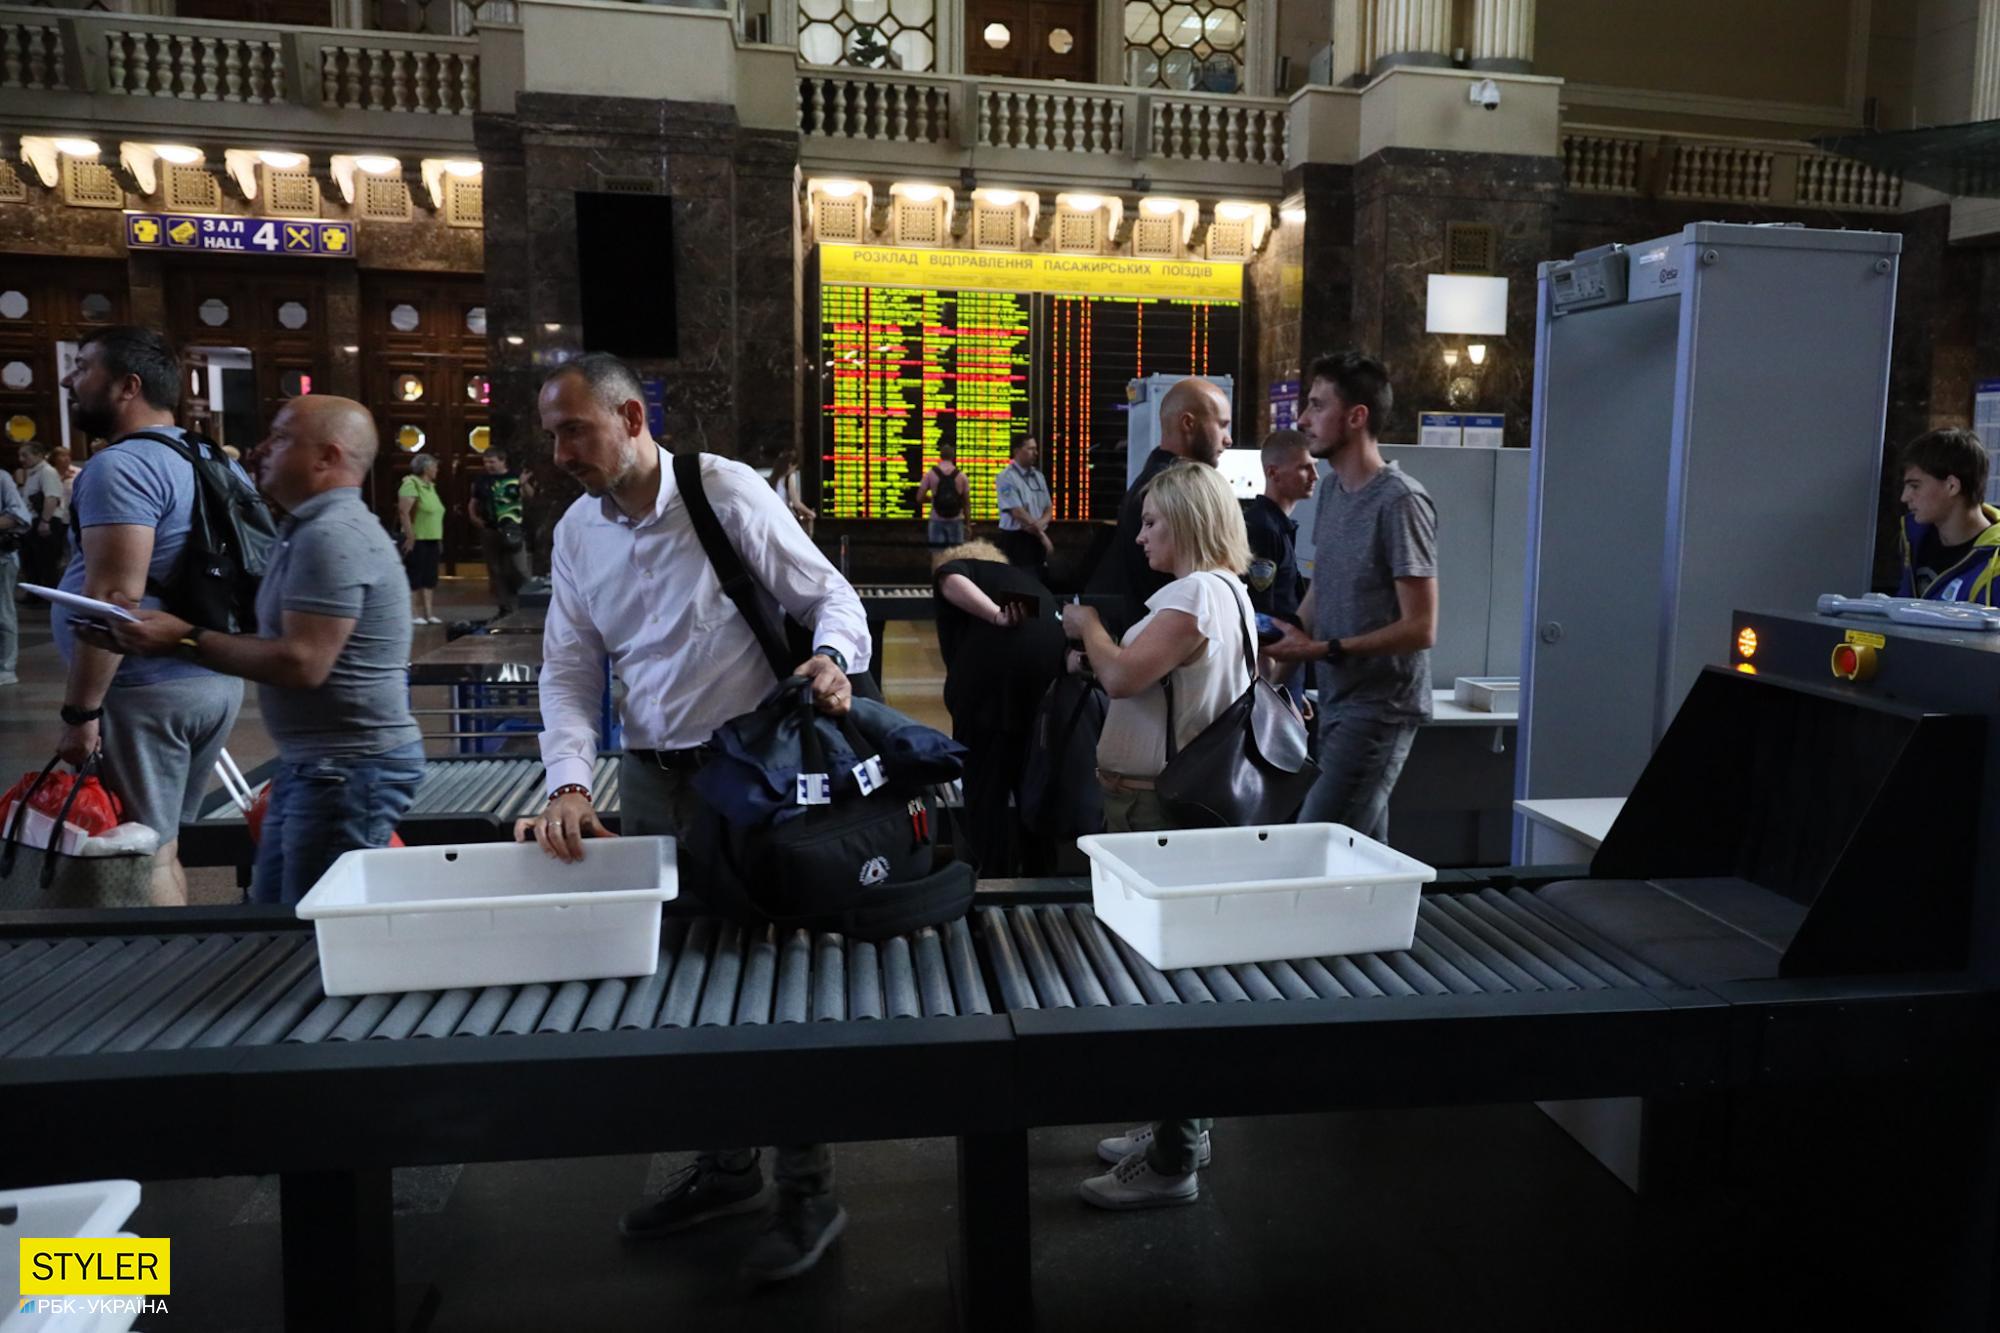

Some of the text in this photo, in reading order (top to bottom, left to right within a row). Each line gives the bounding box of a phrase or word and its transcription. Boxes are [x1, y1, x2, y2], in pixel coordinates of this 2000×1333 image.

[203, 220, 244, 233] ЗАЛ
[252, 222, 279, 251] 4
[204, 237, 244, 249] HALL
[853, 250, 1213, 278] РОЗКЛАД ВІДПРАВЛЕННЯ ПАСАЖИРСЬКИХ ПОЇЗДІВ
